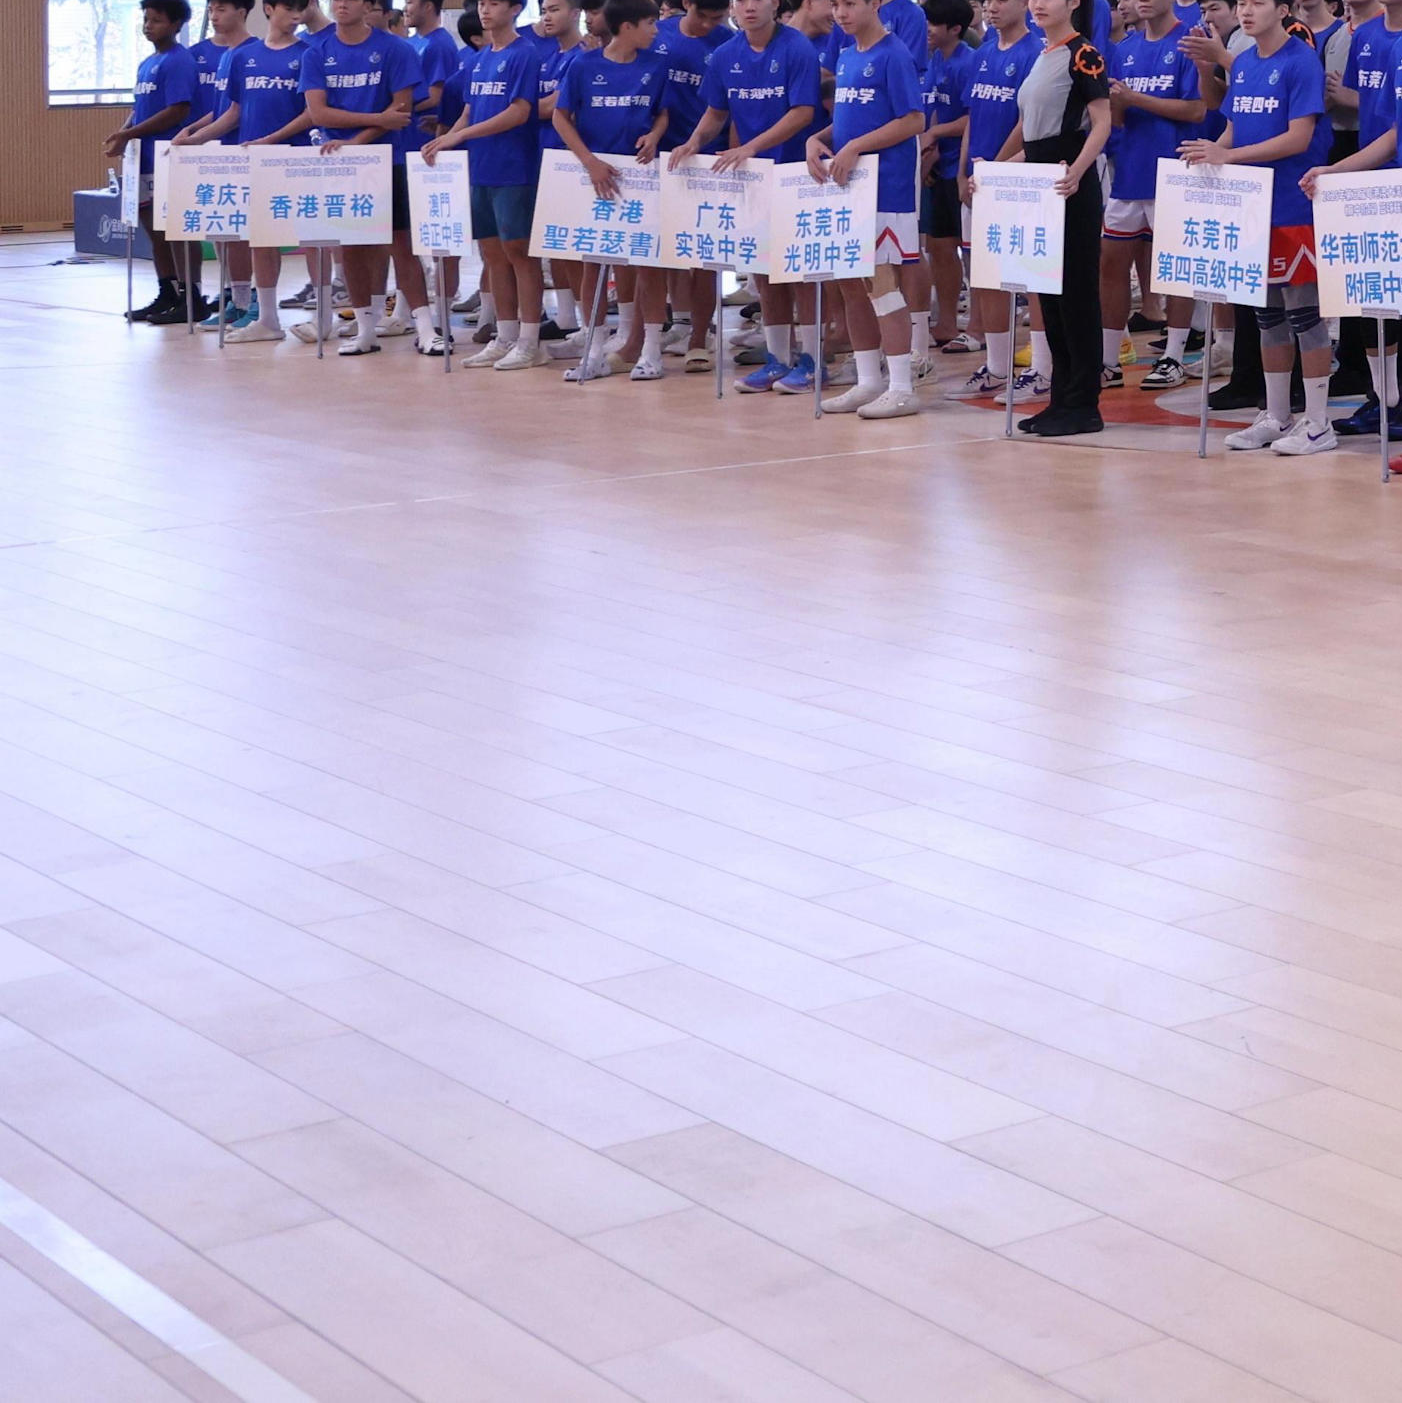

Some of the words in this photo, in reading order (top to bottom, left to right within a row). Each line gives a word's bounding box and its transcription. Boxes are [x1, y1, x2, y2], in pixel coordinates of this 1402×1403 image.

[269, 194, 375, 220] 香港晋裕
[591, 198, 644, 224] 香港
[696, 201, 736, 231] 广东
[795, 206, 853, 239] 东莞市
[542, 225, 660, 259] 聖若瑟書
[675, 231, 757, 265] 实验中学
[986, 222, 1047, 257] 裁判员
[1182, 217, 1241, 253] 东莞市
[784, 239, 861, 273] 光明中学
[1156, 251, 1263, 294] 第四高级中学
